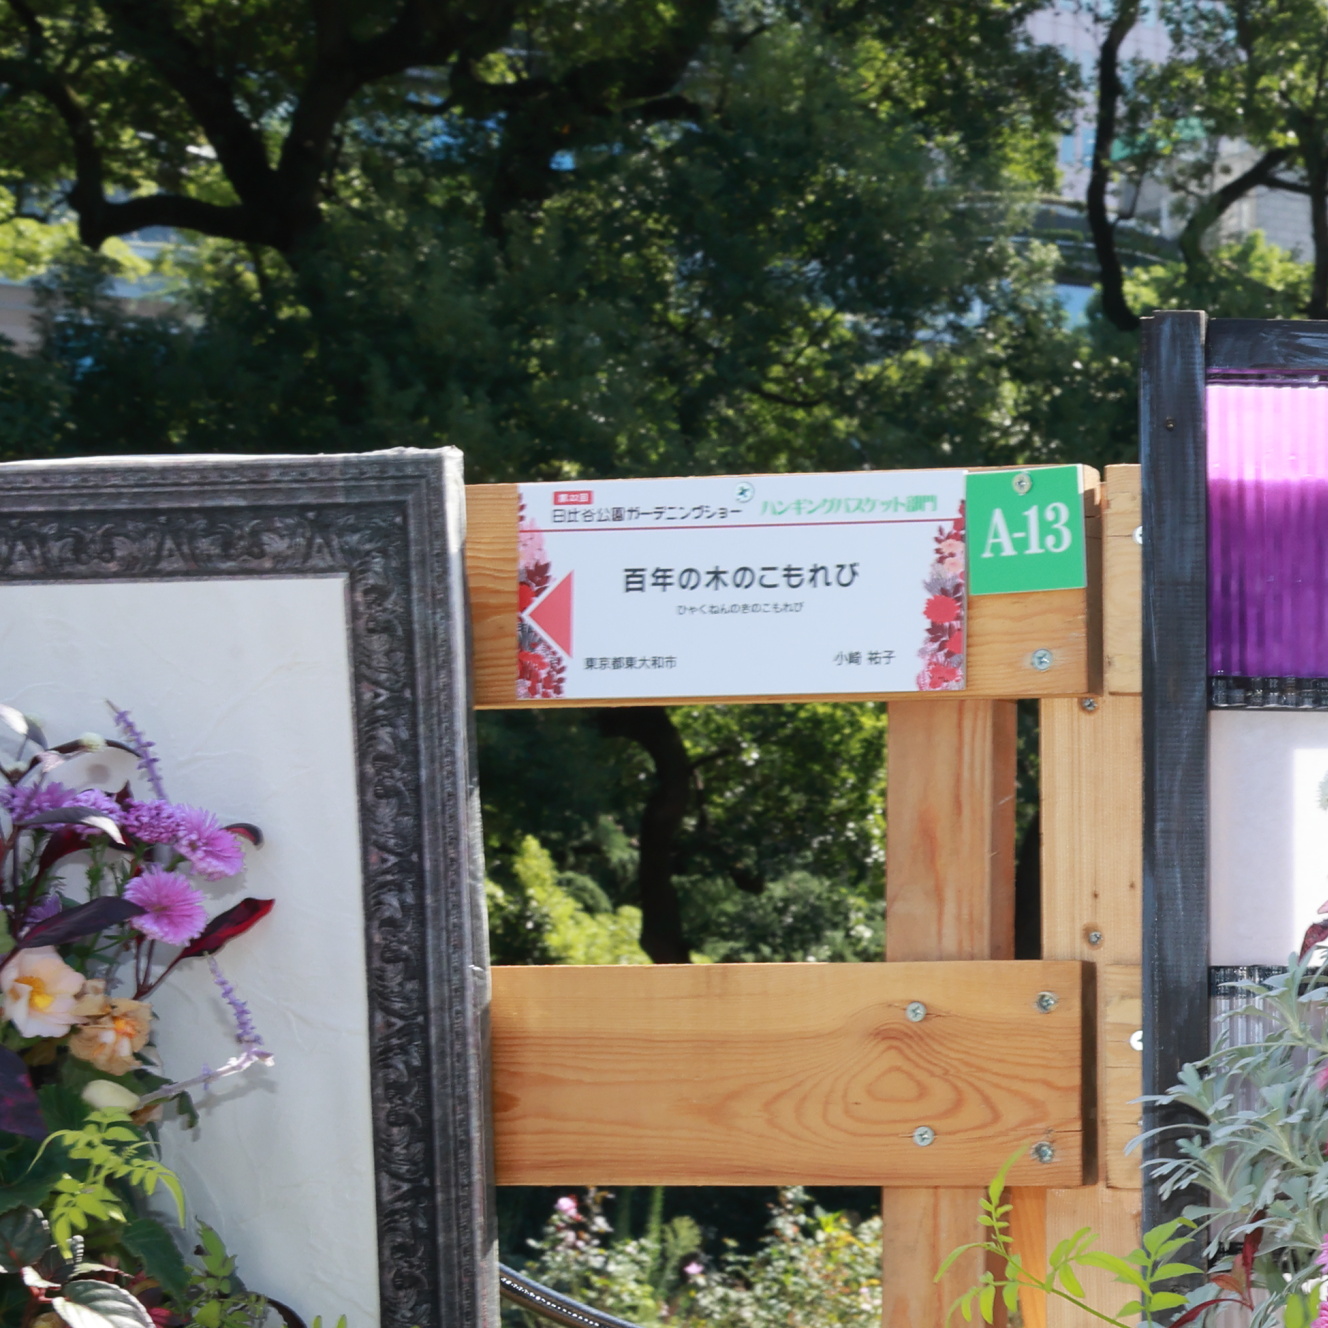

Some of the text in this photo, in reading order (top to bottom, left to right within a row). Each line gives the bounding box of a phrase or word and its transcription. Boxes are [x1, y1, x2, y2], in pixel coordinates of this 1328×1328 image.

[760, 495, 938, 515] ハンギングバスケット部門
[553, 506, 743, 523] 日比谷公園ガーデニングショー
[982, 501, 1073, 559] A-13
[623, 562, 860, 593] 百年の木のこもれび
[676, 601, 805, 616] ひゃくねんのきのこもれび
[583, 655, 678, 671] 東京都東大和市
